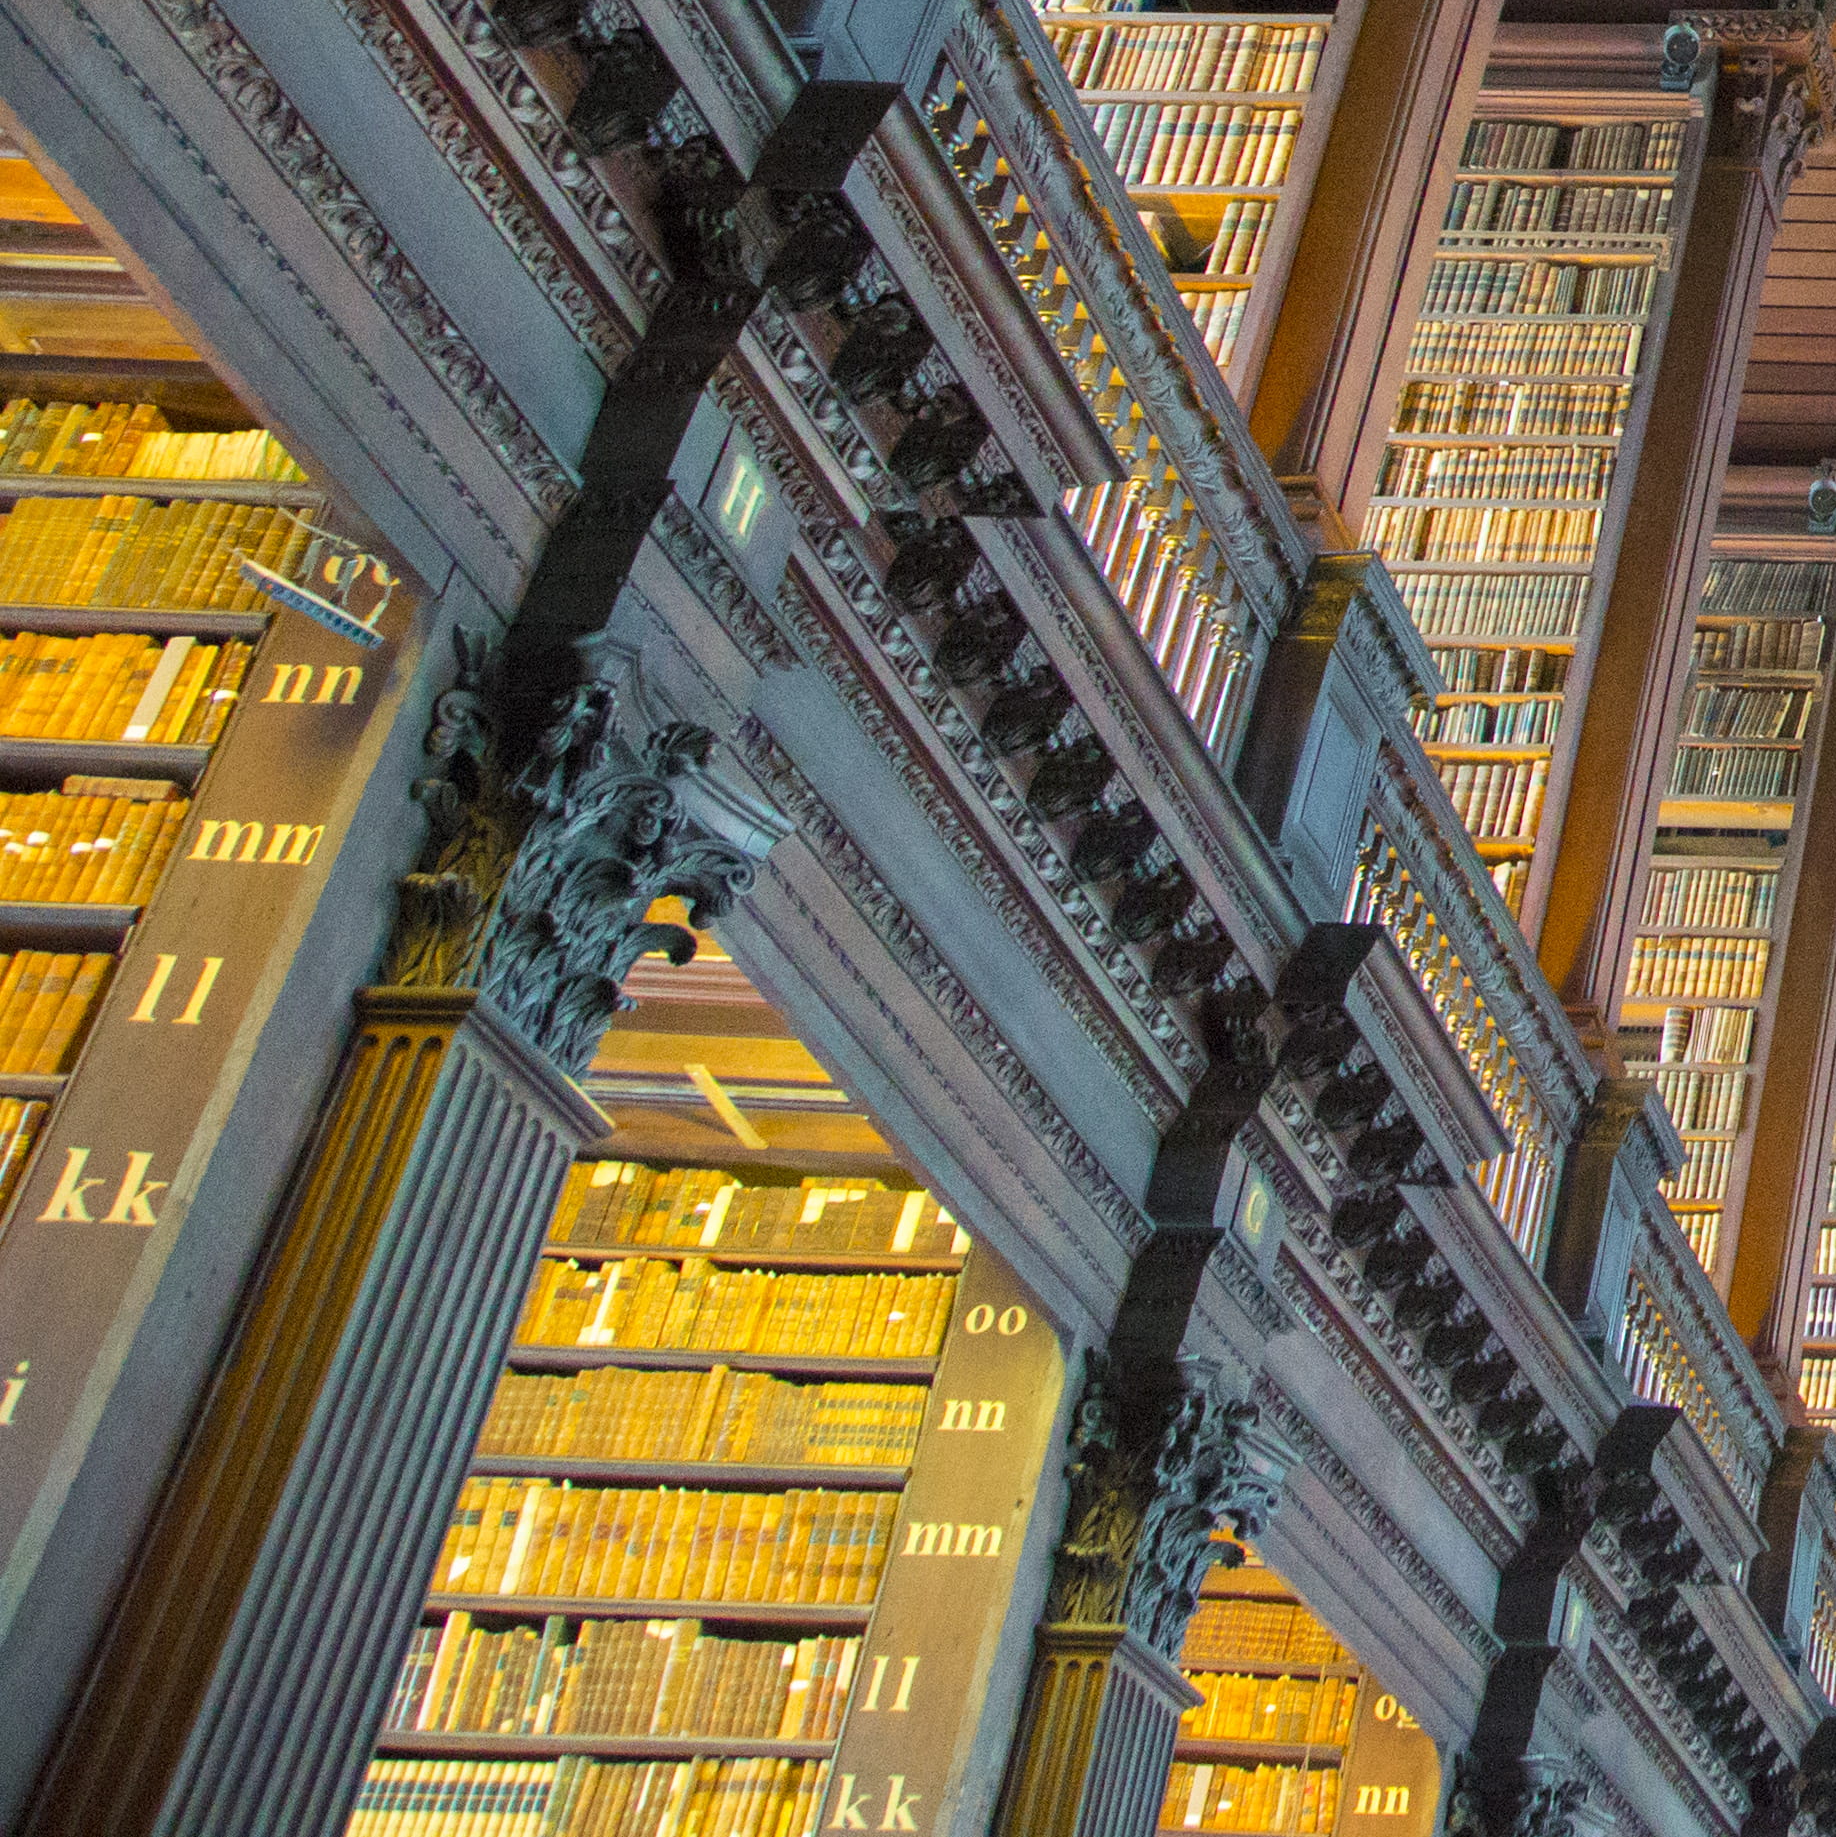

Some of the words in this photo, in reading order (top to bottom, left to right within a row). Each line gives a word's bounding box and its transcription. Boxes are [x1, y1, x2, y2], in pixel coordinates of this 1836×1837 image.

[722, 465, 762, 536] H
[261, 662, 363, 704] nn
[187, 820, 325, 866] mm
[36, 1147, 168, 1226] kk
[964, 1304, 1027, 1336] oo
[938, 1398, 1006, 1432] nn
[902, 1521, 1003, 1557] mm
[827, 1774, 921, 1831] kk
[1353, 1785, 1410, 1815] nn
